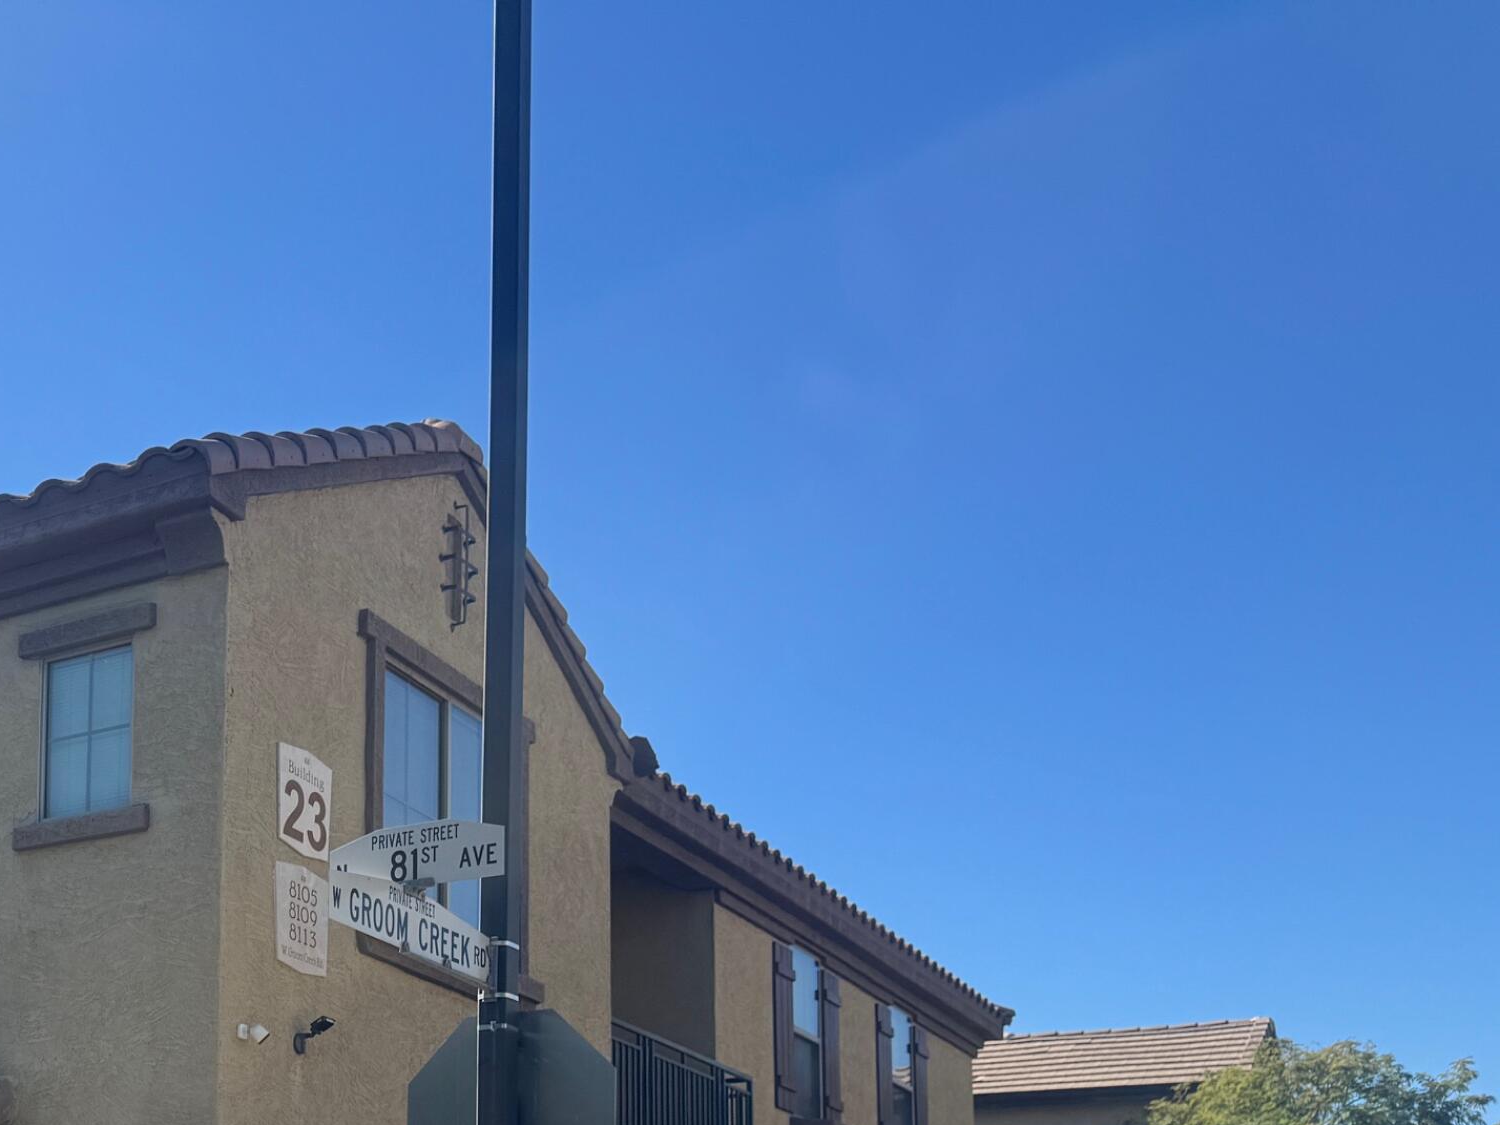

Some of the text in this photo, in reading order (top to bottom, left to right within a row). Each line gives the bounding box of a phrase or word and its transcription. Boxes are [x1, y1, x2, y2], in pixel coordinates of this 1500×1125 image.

[288, 759, 325, 792] Building
[283, 780, 327, 852] 23
[372, 824, 460, 850] PRIVATE STREET
[459, 843, 498, 868] AVE
[289, 880, 318, 907] 8105
[390, 885, 436, 919] PRIVATE STREET
[289, 901, 318, 926] 8109
[332, 886, 486, 968] W GROOM CREEK RD
[289, 923, 316, 949] 8113
